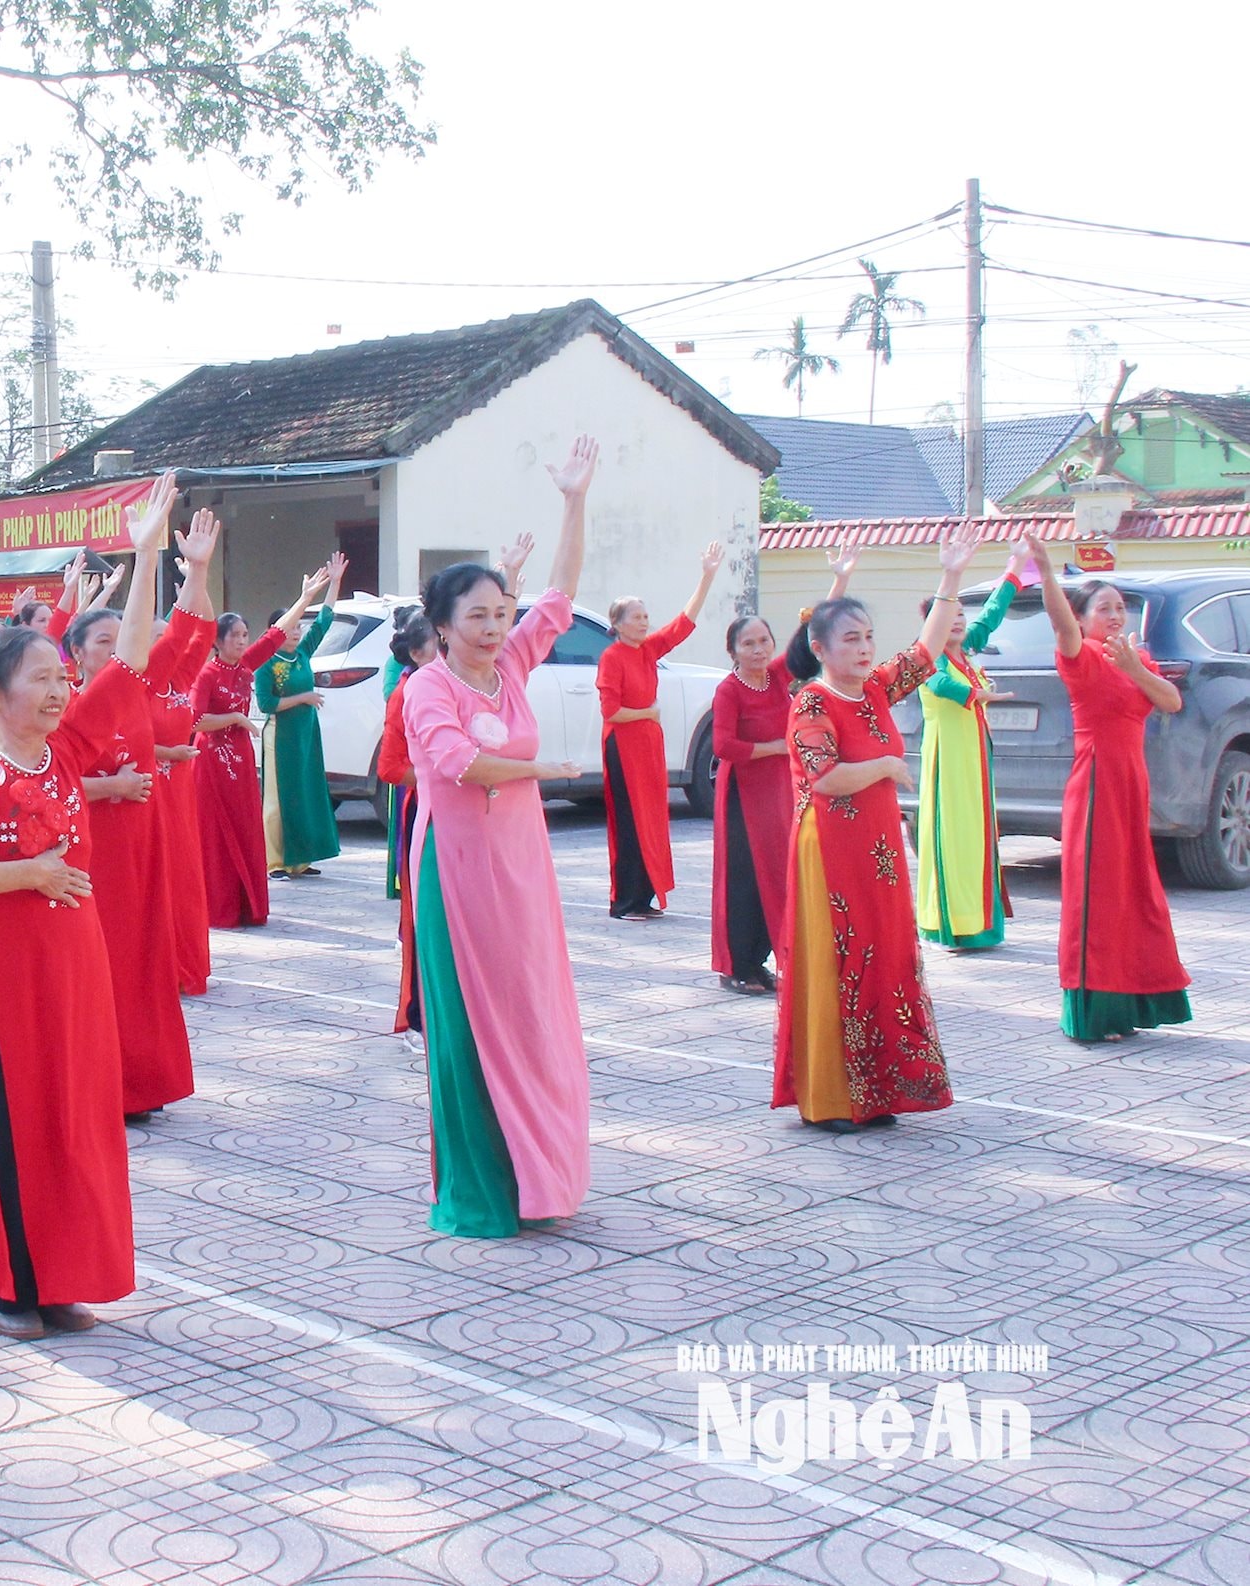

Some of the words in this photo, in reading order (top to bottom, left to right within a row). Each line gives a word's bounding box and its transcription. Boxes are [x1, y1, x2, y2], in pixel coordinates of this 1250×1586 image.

[3, 510, 34, 548] PHÁP
[36, 507, 52, 545] VÀ
[55, 502, 88, 543] PHÁP
[91, 498, 122, 545] LUẬT
